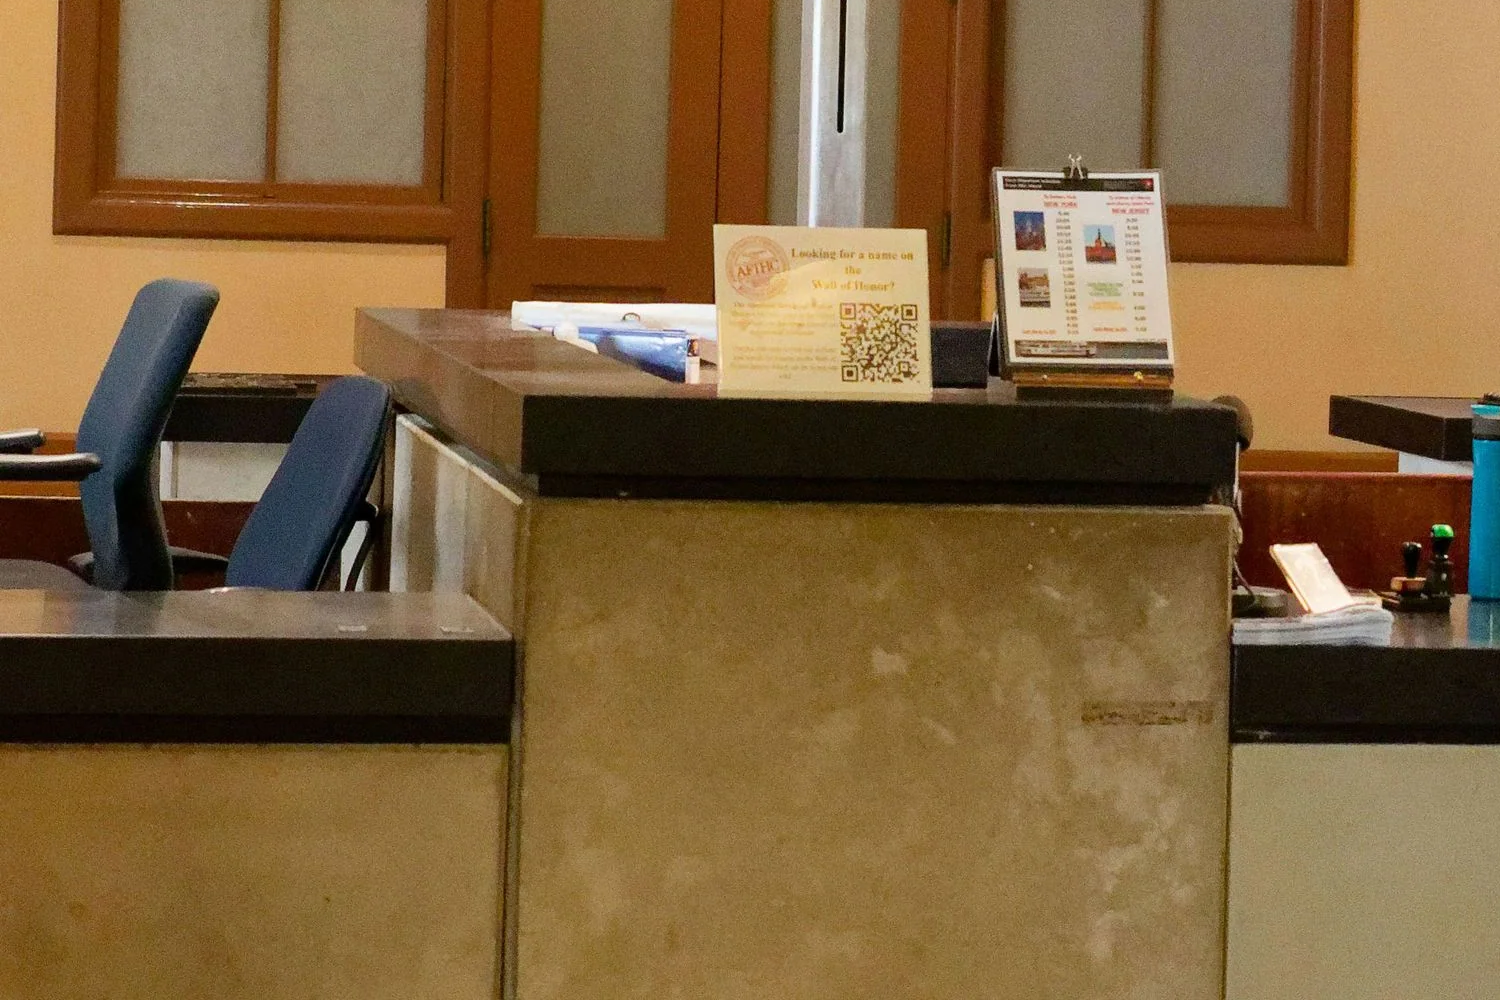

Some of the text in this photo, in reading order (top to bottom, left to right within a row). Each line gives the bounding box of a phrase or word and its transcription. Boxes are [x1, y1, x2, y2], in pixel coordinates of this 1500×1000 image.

[791, 248, 914, 261] Looking for a name on
[845, 265, 862, 275] the
[840, 281, 854, 291] of
